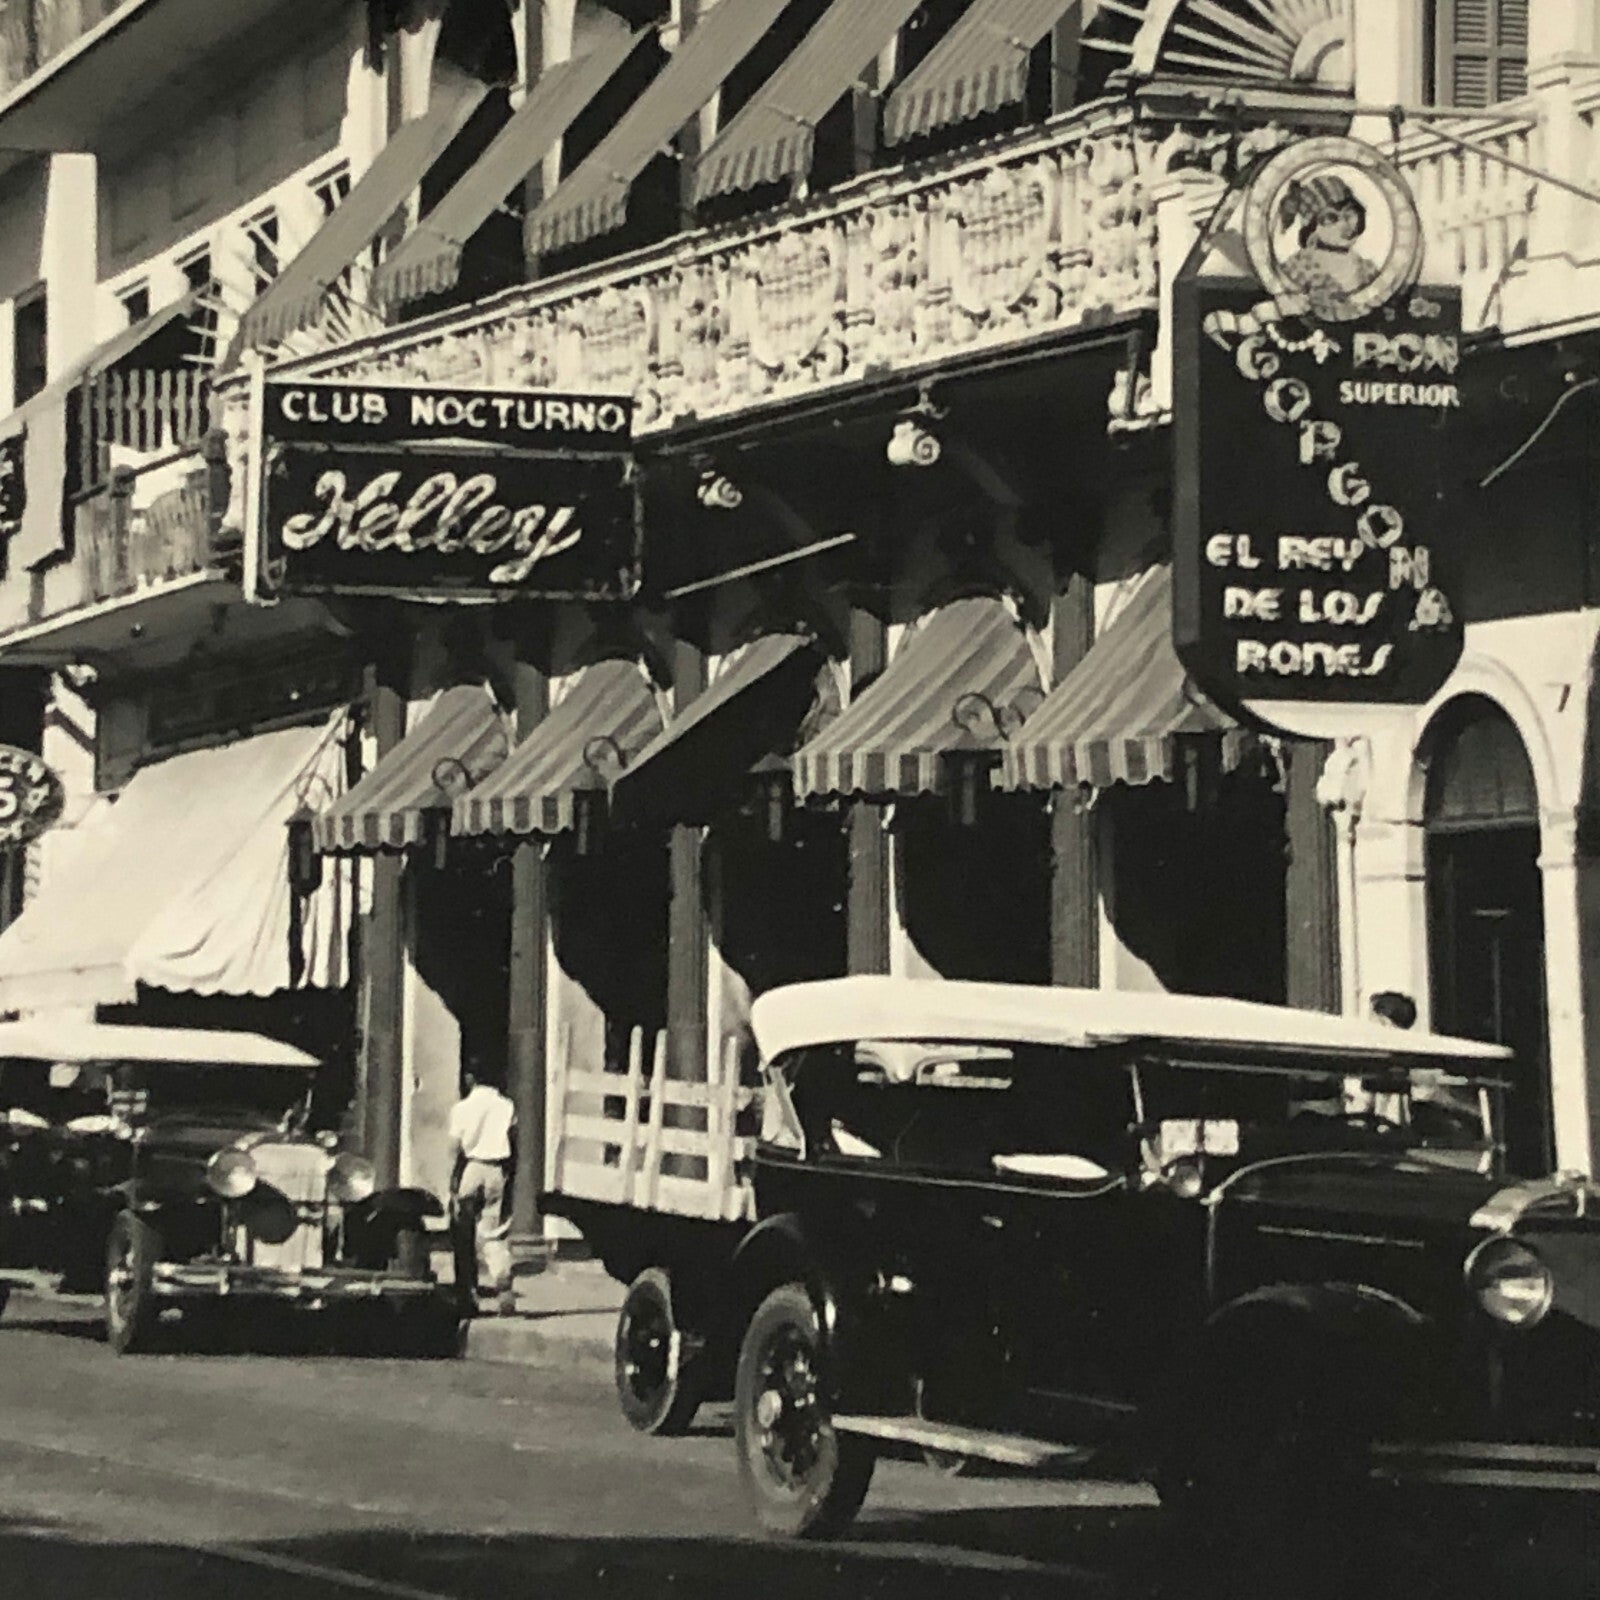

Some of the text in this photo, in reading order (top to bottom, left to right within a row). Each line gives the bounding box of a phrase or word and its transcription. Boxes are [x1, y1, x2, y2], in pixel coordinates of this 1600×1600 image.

[1353, 332, 1457, 372] RON
[281, 390, 625, 431] CLUB NOCTURNO
[1339, 381, 1458, 406] SUPERIOR
[1206, 533, 1362, 569] EL REY
[1223, 586, 1384, 623] DE LOS
[1236, 639, 1392, 675] RONES
